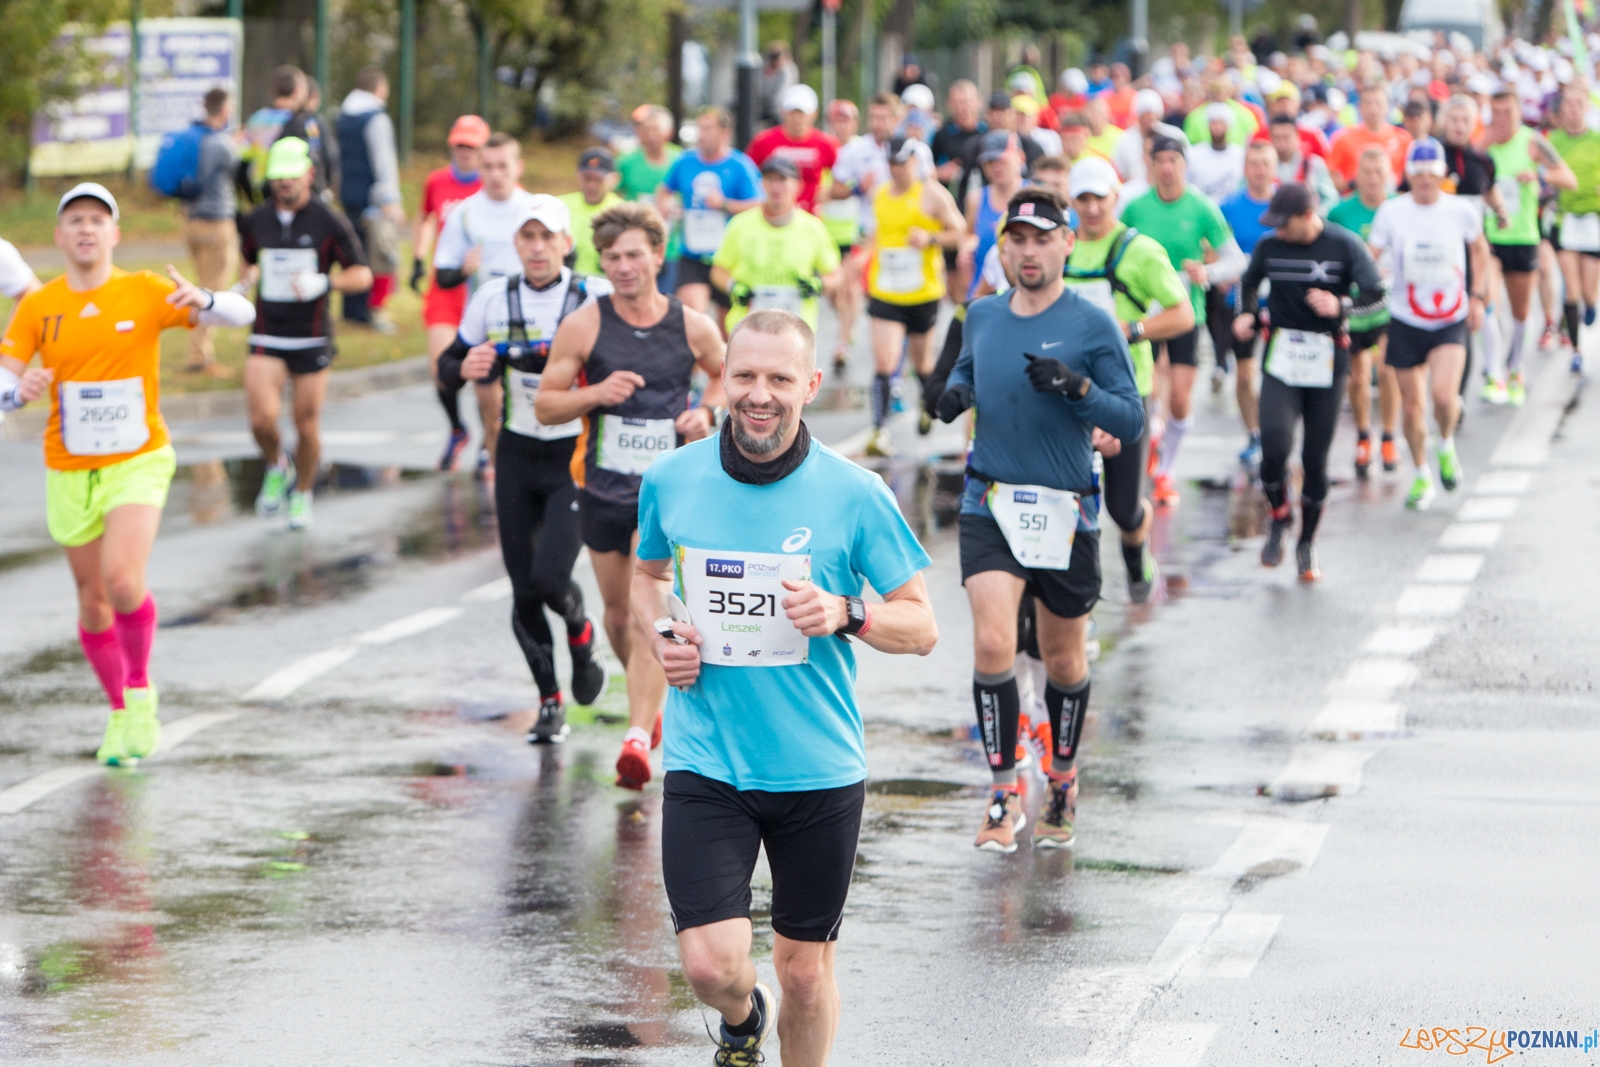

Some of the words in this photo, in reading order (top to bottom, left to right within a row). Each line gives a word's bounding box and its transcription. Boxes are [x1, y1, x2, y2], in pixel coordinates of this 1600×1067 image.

[79, 404, 130, 423] 2650
[618, 432, 669, 450] 6606
[1020, 512, 1048, 531] 551
[708, 590, 776, 617] 3521
[721, 621, 762, 633] Leszek
